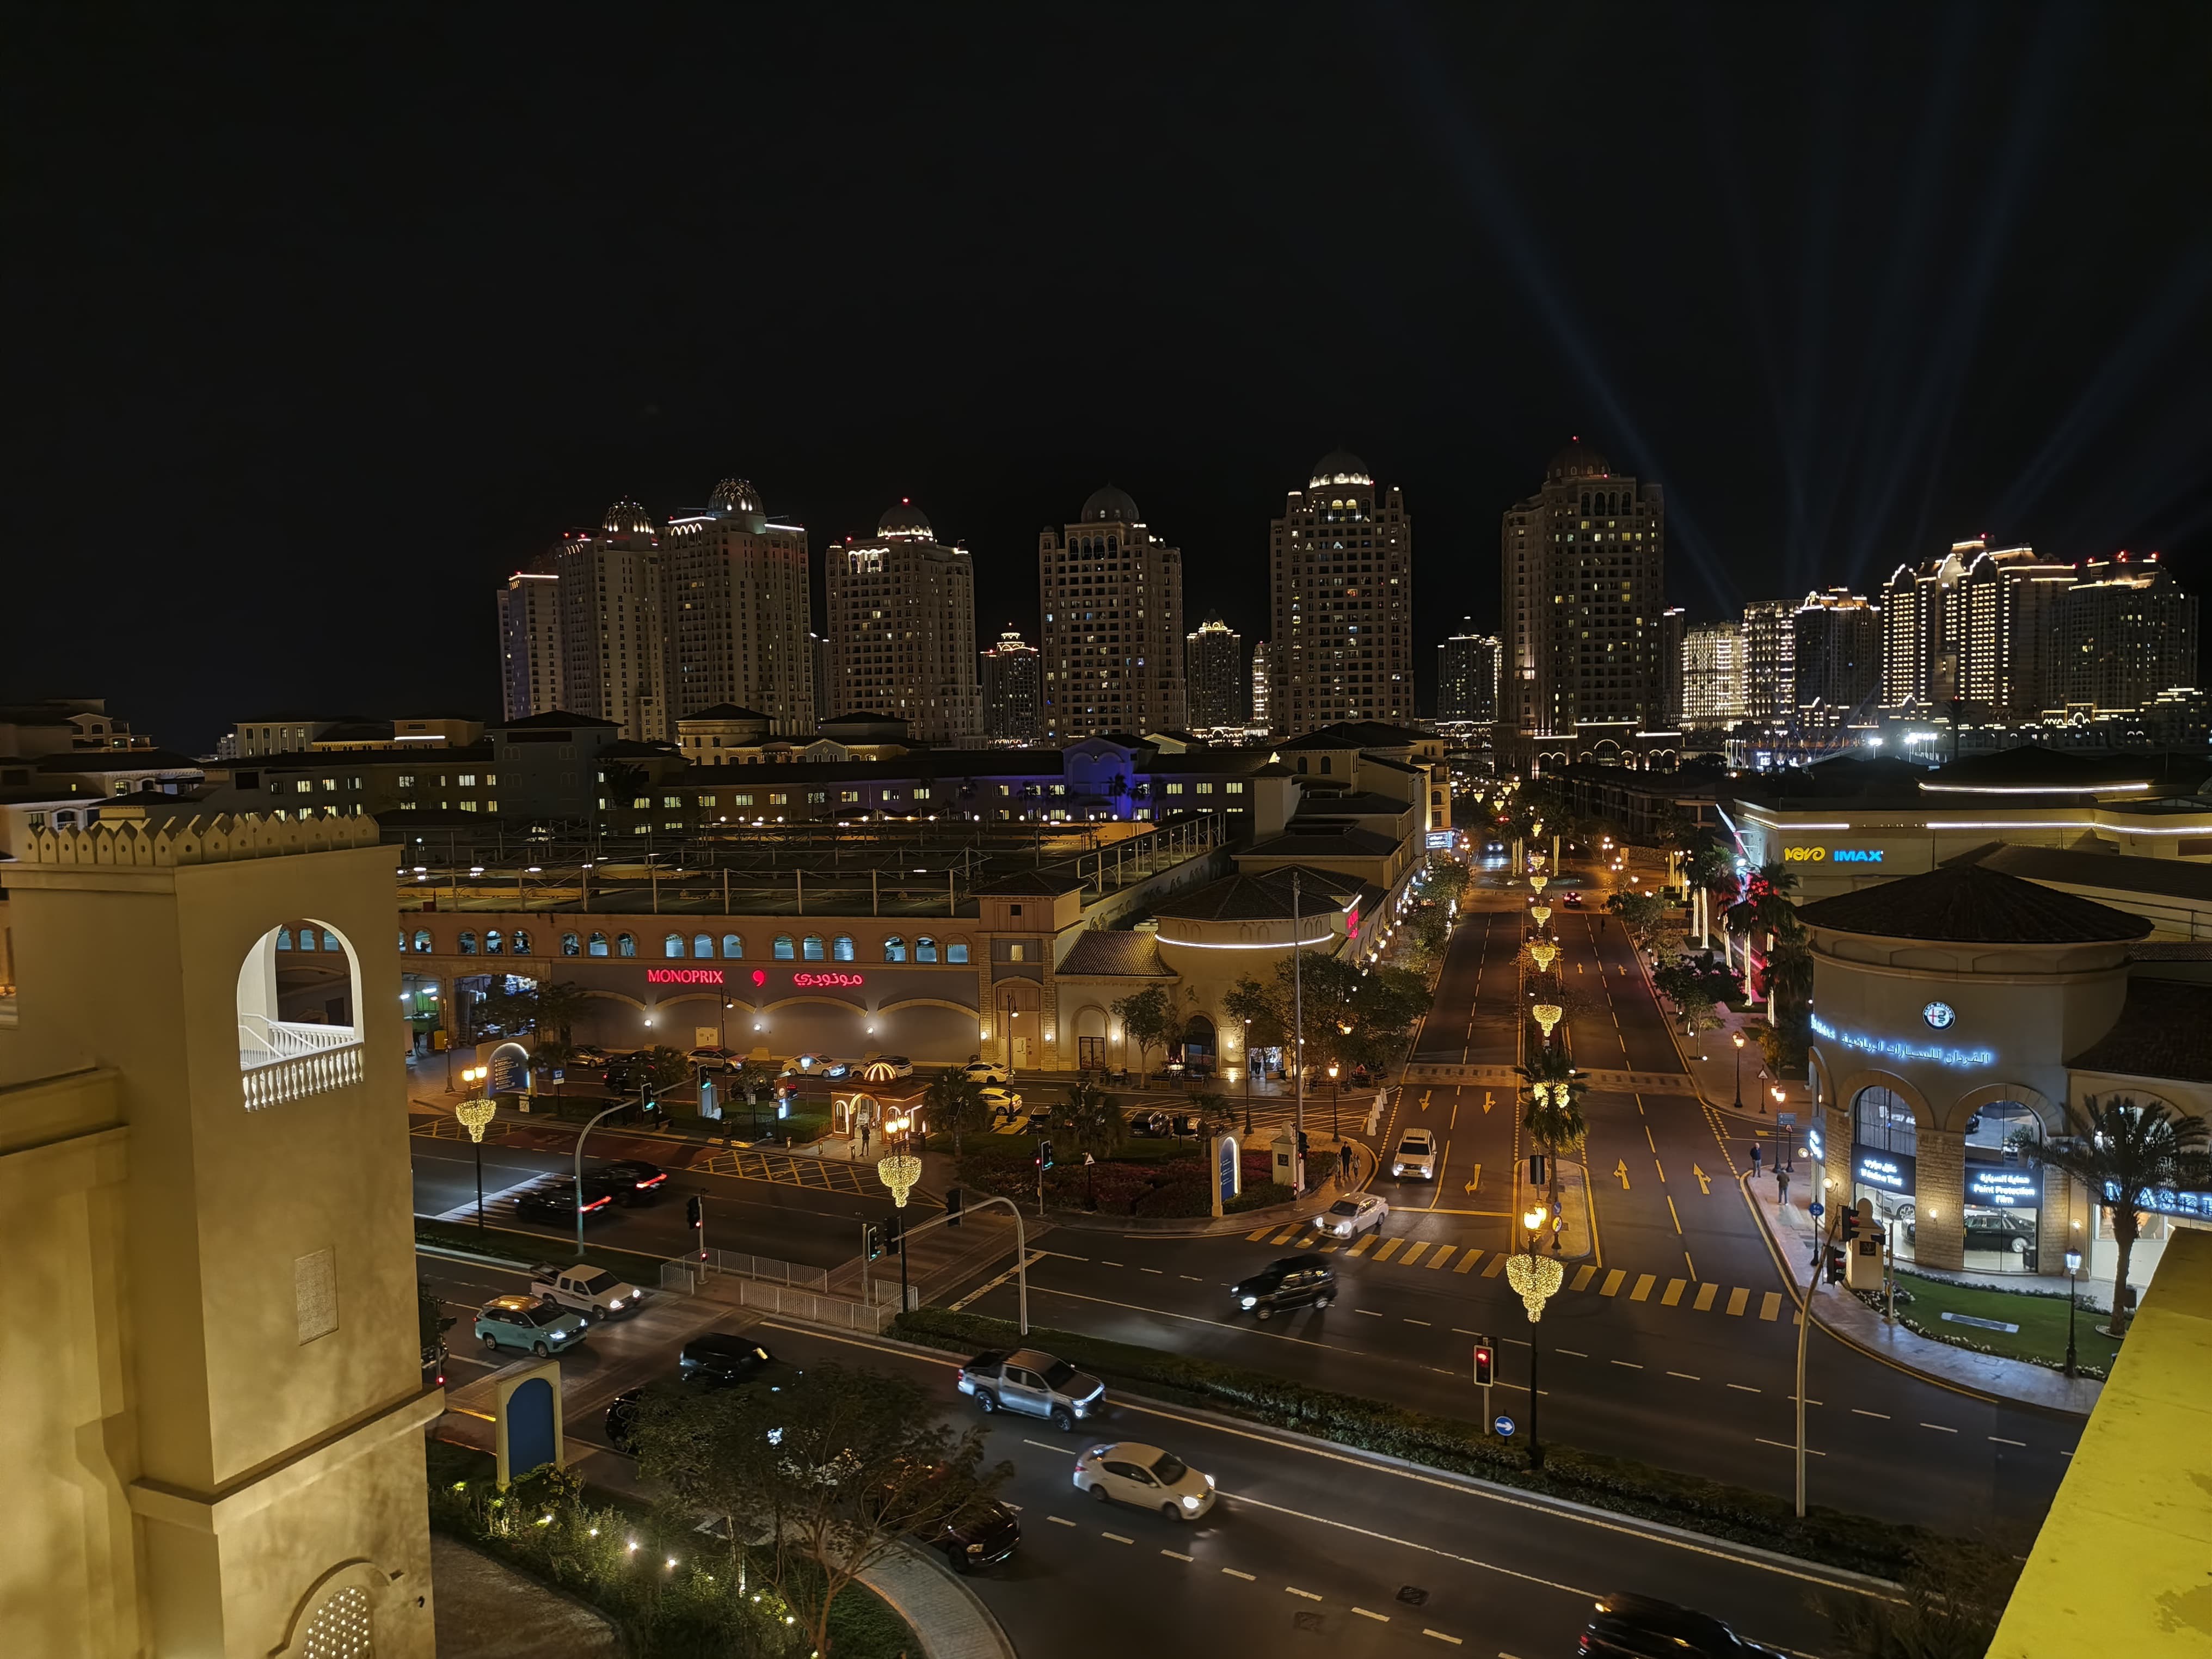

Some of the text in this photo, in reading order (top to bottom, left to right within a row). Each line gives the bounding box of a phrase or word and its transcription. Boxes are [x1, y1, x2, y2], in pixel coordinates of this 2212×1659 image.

[1834, 850, 1882, 862] IMAX
[648, 969, 723, 984] MONOPRIX
[794, 973, 864, 987] مونوبري
[1973, 1183, 2036, 1196] Paint Protection
[1995, 1195, 2014, 1205] Film
